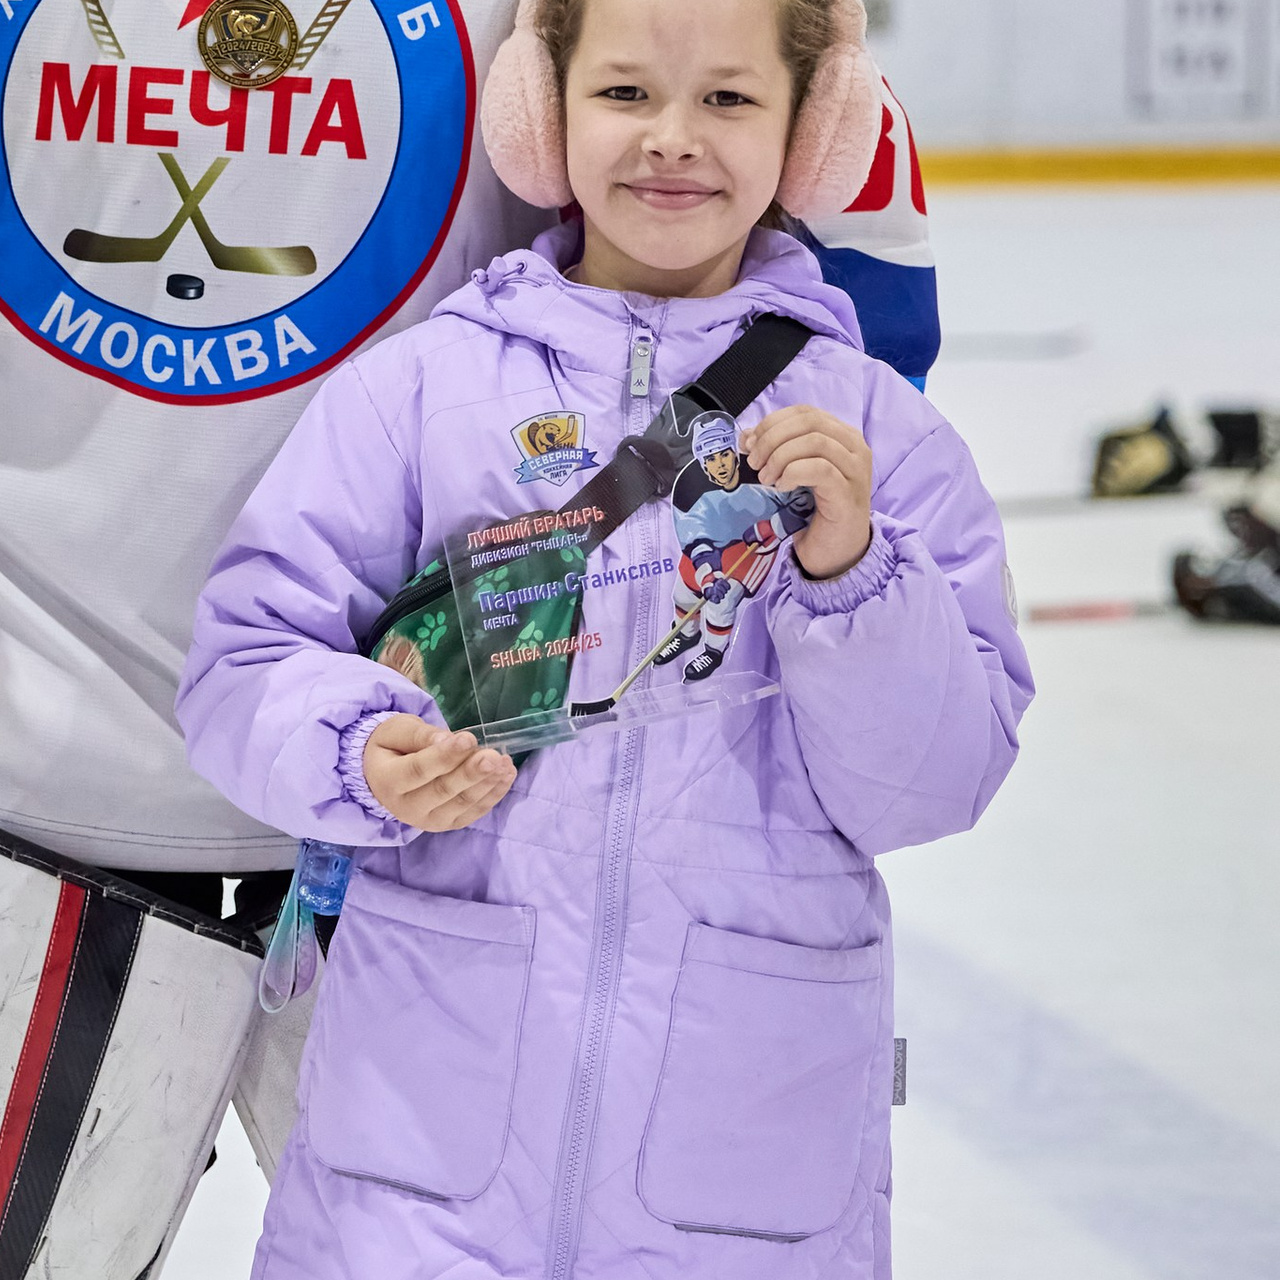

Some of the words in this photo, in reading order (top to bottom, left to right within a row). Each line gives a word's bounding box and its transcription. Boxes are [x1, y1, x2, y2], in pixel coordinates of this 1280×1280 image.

[220, 41, 277, 55] 2024/2025
[35, 61, 368, 160] МЕЧТА
[38, 291, 318, 387] МОСКВА
[528, 450, 584, 471] СЕВЕРНАЯ
[550, 470, 568, 480] ЛИГА
[467, 517, 532, 549] ЛУЧШИЙ
[533, 506, 605, 536] ВРАТАРЬ
[471, 544, 530, 568] ДИВИЗИОН
[478, 581, 559, 613] Паршин
[564, 557, 675, 594] Станислав
[483, 614, 518, 631] МЕЧТА
[490, 646, 542, 669] SHLIGA
[545, 632, 602, 657] 2024/25
